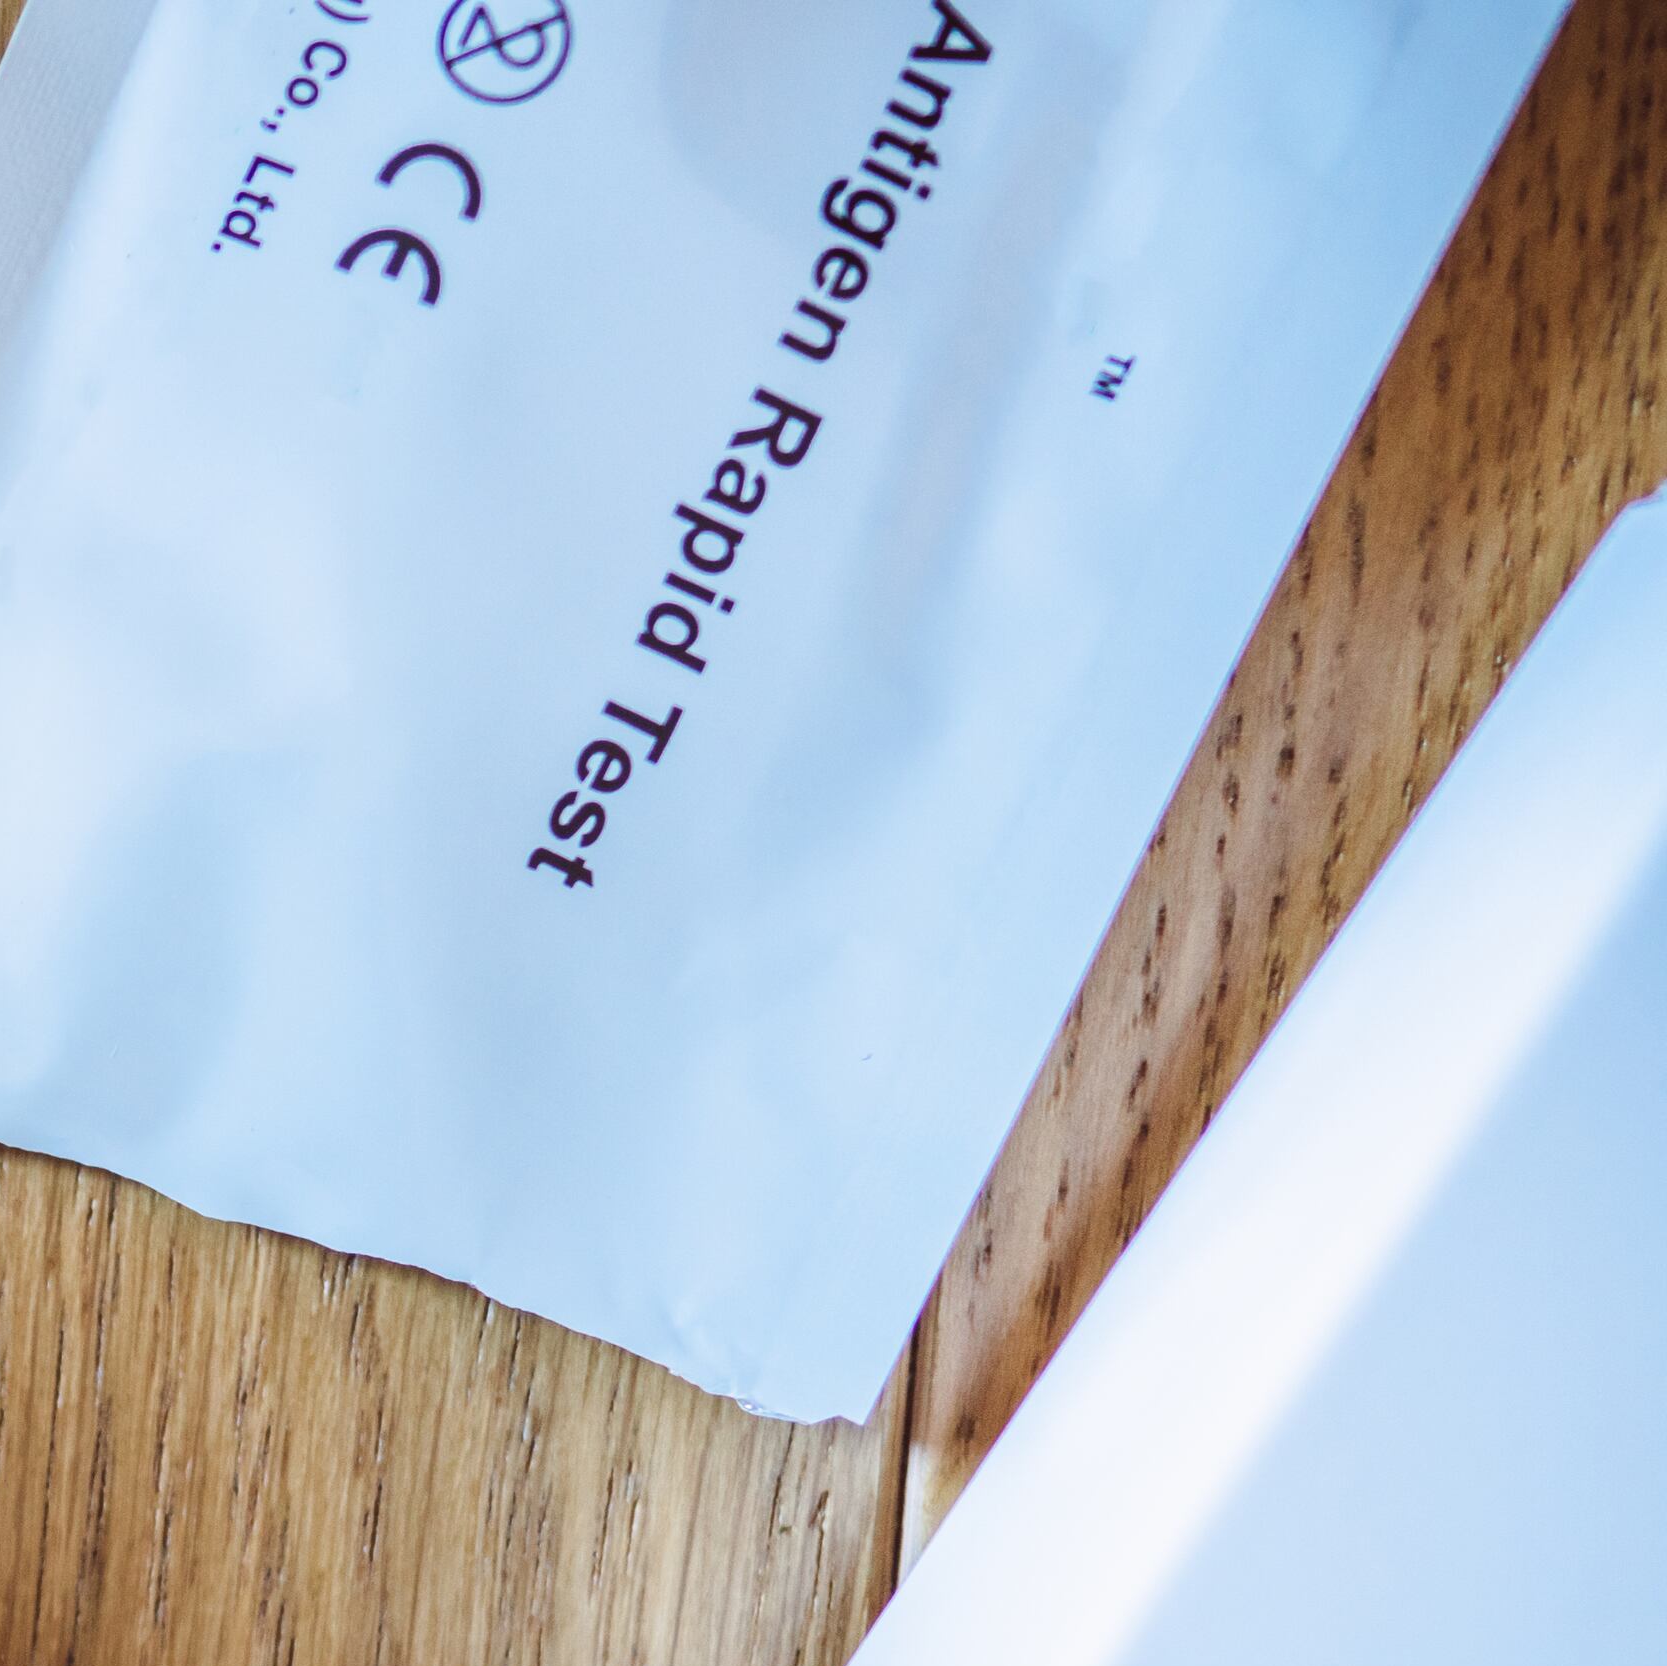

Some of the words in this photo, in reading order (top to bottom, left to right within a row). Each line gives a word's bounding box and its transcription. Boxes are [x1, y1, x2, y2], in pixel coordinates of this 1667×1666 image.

[260, 39, 348, 133] Co.,
[210, 154, 296, 253] Ltd.
[334, 141, 484, 307] CE
[778, 0, 994, 363] Antigen
[635, 386, 824, 675] Rapid
[526, 699, 684, 889] Test
